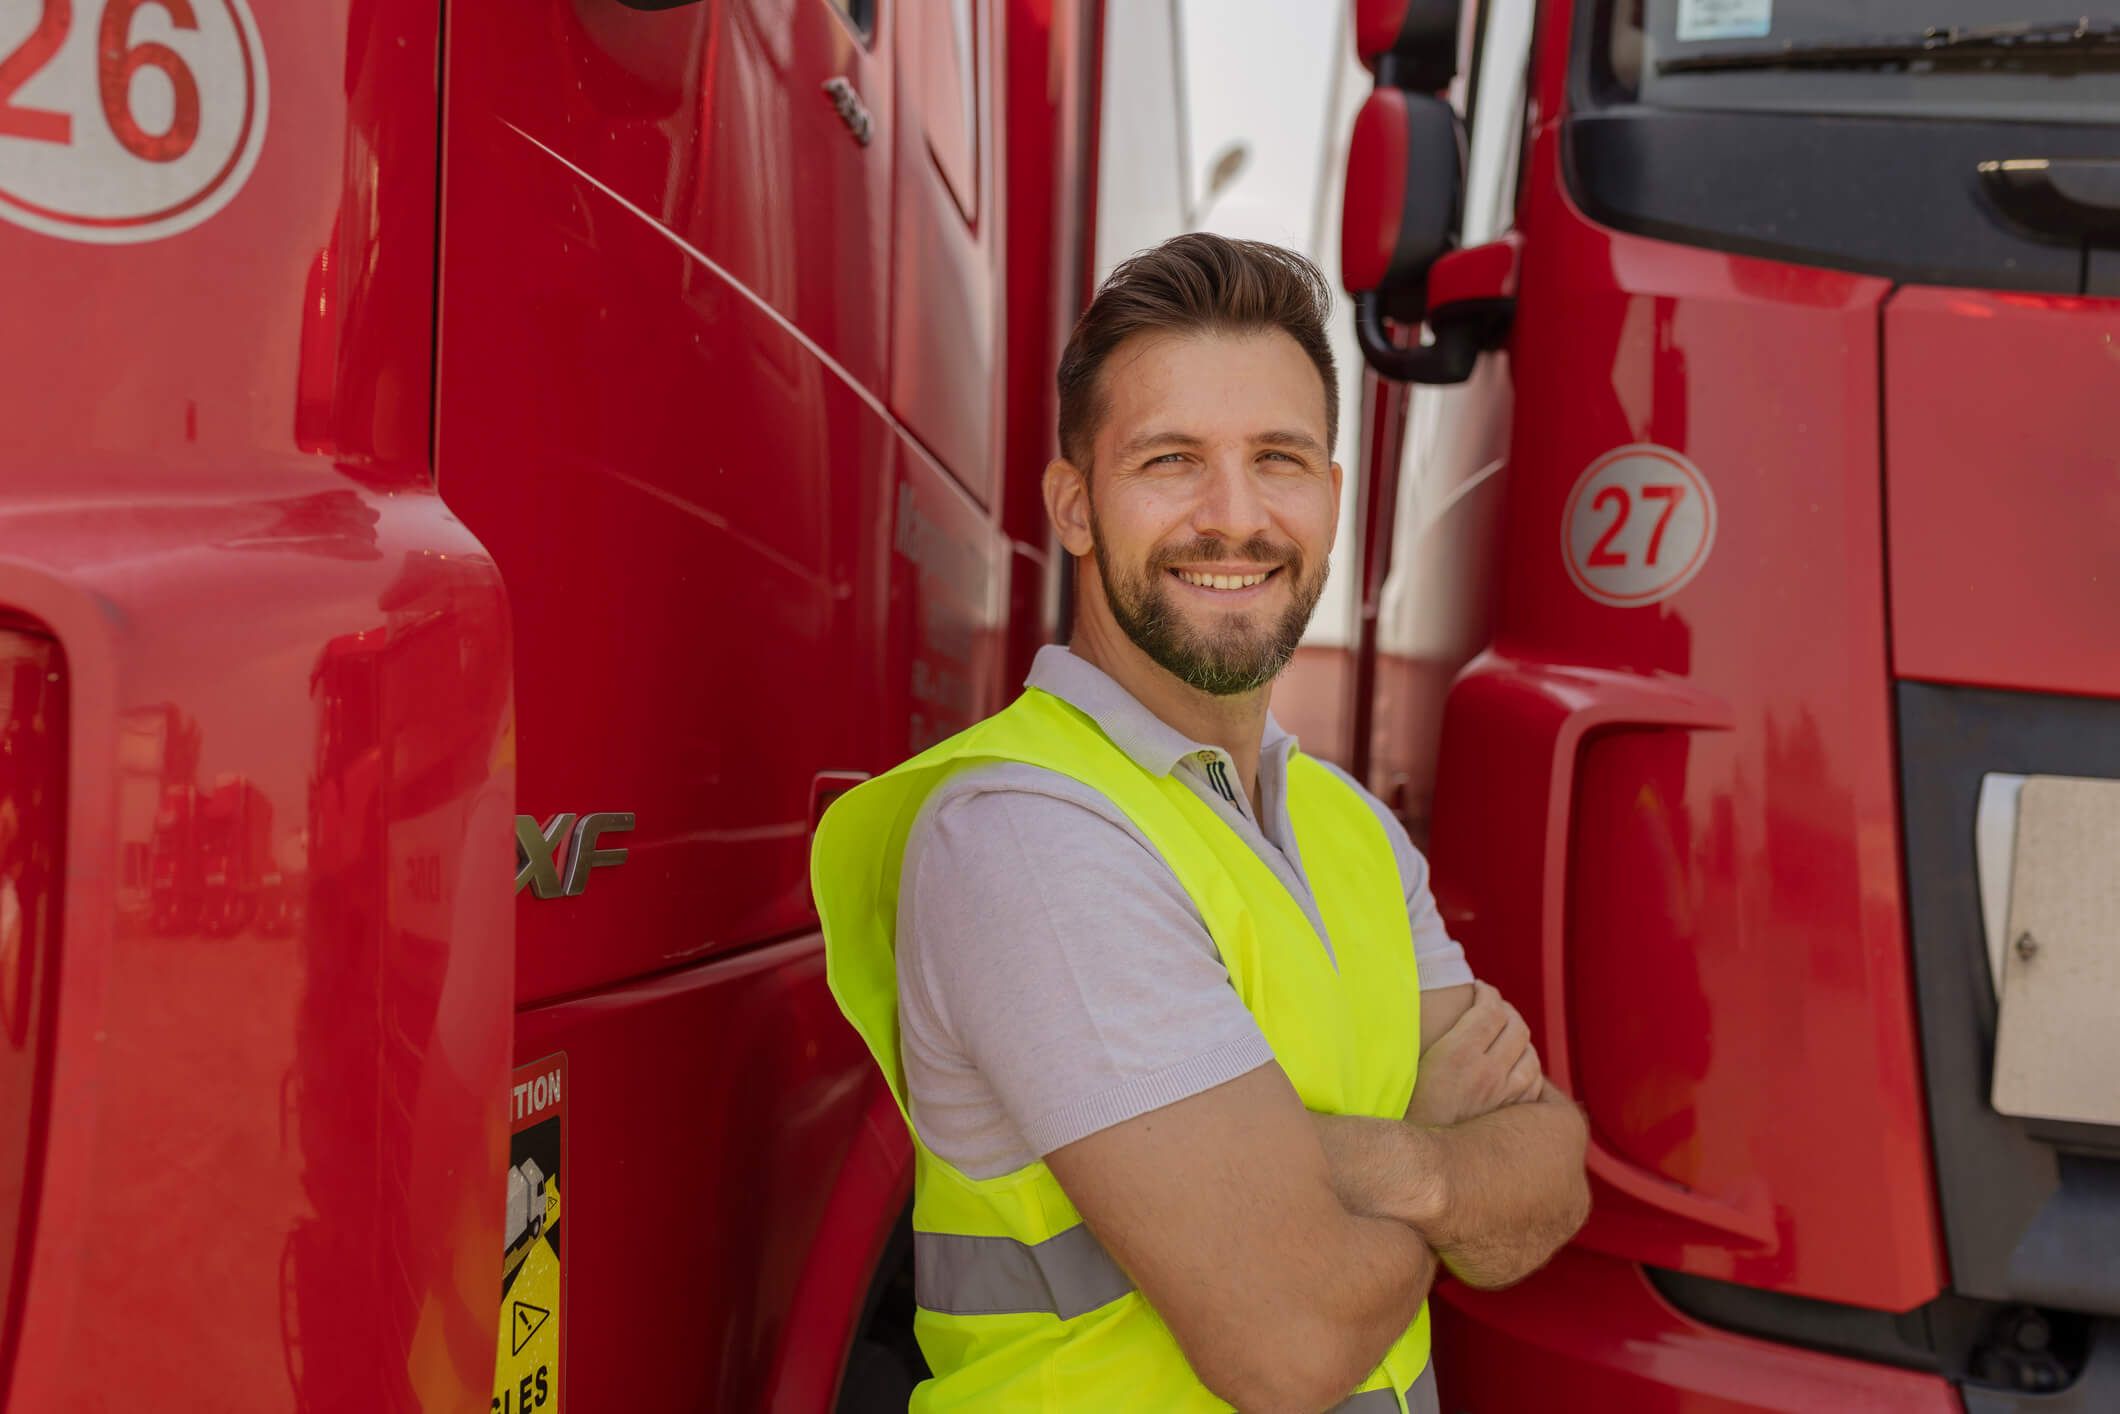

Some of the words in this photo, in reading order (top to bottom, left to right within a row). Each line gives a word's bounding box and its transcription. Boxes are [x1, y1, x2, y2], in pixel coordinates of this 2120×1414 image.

[0, 0, 202, 164] 26
[1586, 484, 1687, 567] 27
[514, 812, 635, 899] XF
[510, 1068, 561, 1123] TION
